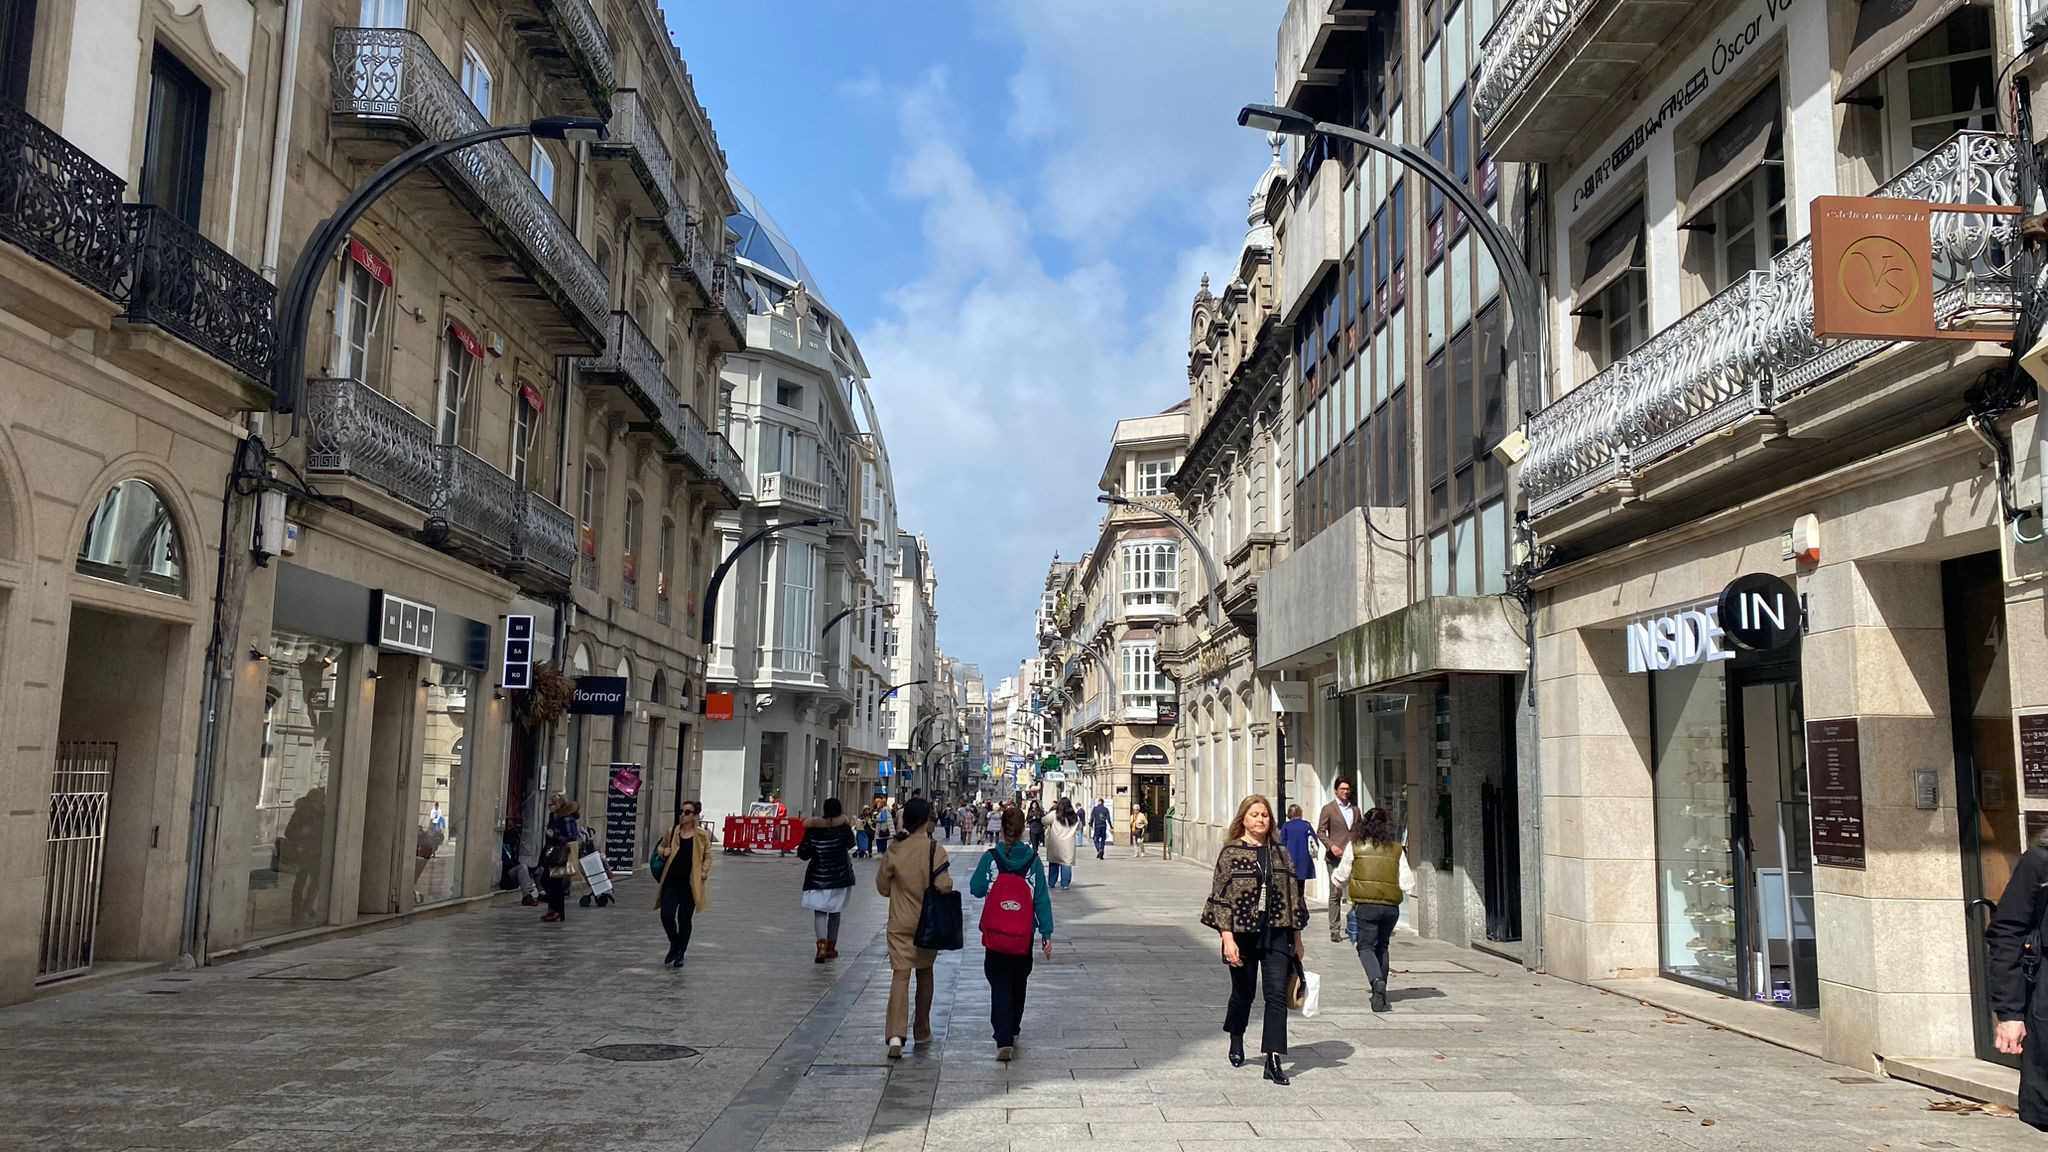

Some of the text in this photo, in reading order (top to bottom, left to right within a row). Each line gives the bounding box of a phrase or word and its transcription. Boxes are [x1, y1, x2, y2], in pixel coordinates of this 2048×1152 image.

[1711, 14, 1762, 75] Óscar
[1740, 592, 1785, 630] IN
[1627, 605, 1736, 674] INSIDE
[573, 688, 622, 702] flormar
[706, 712, 730, 720] orange
